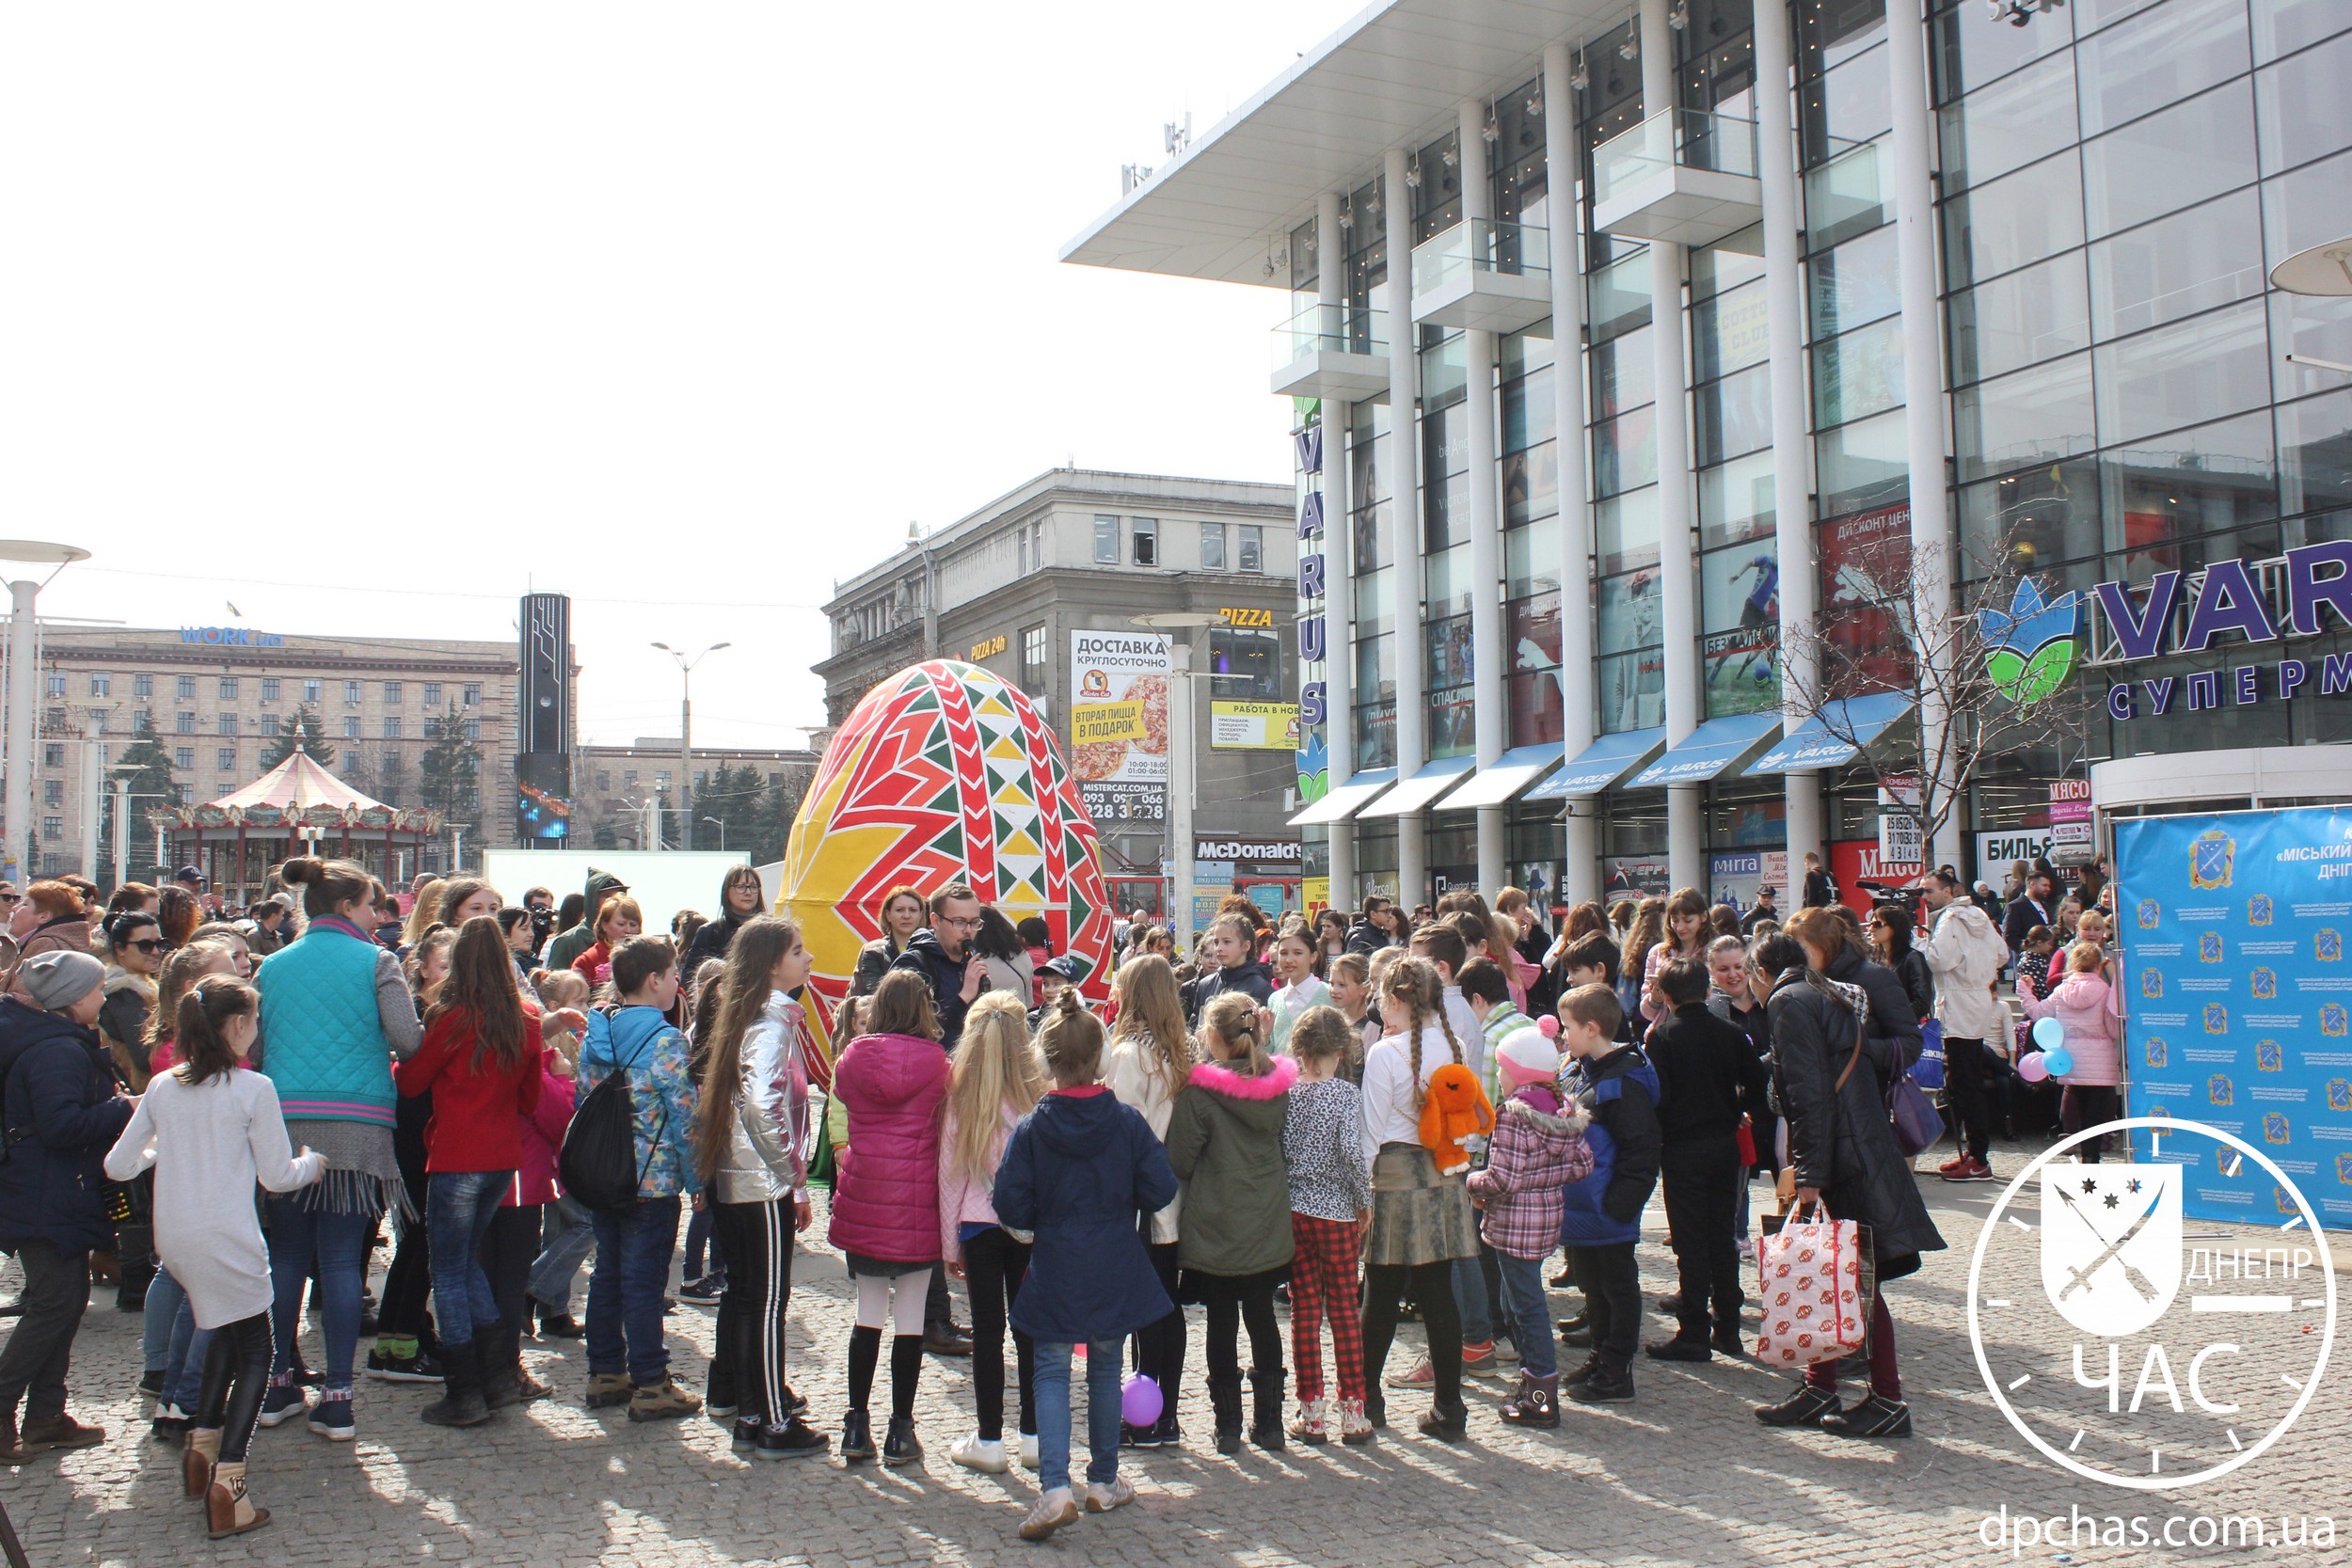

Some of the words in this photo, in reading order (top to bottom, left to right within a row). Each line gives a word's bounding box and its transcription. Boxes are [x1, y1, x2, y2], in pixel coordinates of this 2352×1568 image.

[1295, 425, 1327, 727] VARUS
[2093, 539, 2352, 660] VAR
[1219, 609, 1272, 626] PIZZA
[181, 626, 284, 647] WORK.ua
[971, 640, 991, 662] PIZZA
[991, 635, 1007, 656] 24h
[1077, 639, 1167, 656] ДОСТАВКА
[1077, 656, 1167, 668] КРУГЛОСУТОЧНО
[2107, 652, 2352, 721] СУПЕРМ
[1075, 710, 1106, 723] ВТОРАЯ
[1107, 706, 1136, 721] ПИЦЦА
[1233, 705, 1268, 714] РАБОТА
[1079, 724, 1086, 738] В
[1089, 720, 1135, 736] ПОДАРОК
[1792, 743, 1857, 759] VARUS
[1669, 758, 1729, 773] VARUS
[1777, 755, 1846, 768] СУПЕРМАРКЕТ
[1563, 772, 1615, 786] VARUS
[1655, 769, 1714, 782] СУПЕРМАРКЕТ
[1083, 784, 1163, 792] MISTERCAT.COM.UA
[2049, 781, 2090, 801] МЯСО
[1083, 793, 1104, 803] 093
[1142, 795, 1163, 803] 066
[2276, 841, 2352, 863] «МІСЬКИЙ
